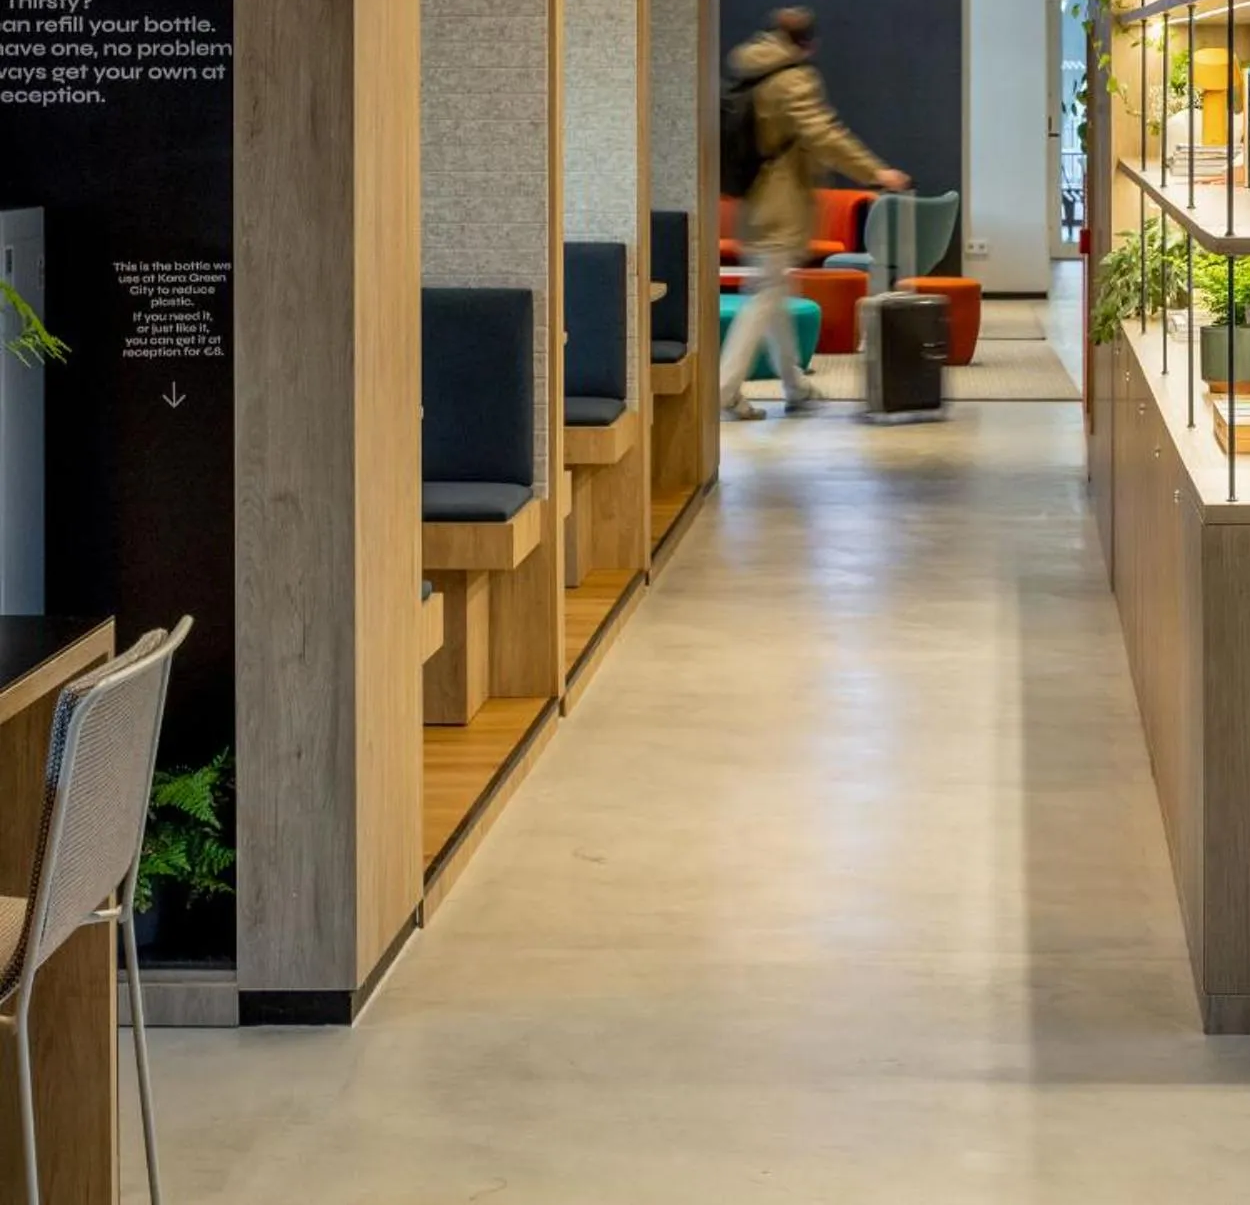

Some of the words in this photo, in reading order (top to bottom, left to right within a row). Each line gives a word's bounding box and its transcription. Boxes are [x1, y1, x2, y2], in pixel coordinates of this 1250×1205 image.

[35, 15, 83, 33] refill
[89, 19, 139, 37] your
[144, 15, 216, 33] bottle.
[51, 43, 98, 59] one,
[103, 43, 132, 57] no
[52, 64, 89, 84] get
[94, 67, 143, 84] your
[148, 67, 196, 80] own
[202, 63, 226, 80] at
[113, 261, 137, 271] This
[139, 261, 149, 271] is
[152, 261, 172, 271] the
[174, 261, 211, 271] bottle
[118, 276, 140, 284] use
[130, 285, 154, 297] City
[157, 285, 170, 295] to
[172, 285, 216, 295] reduce
[133, 311, 142, 321] If
[144, 313, 168, 324] you
[170, 311, 200, 322] need
[137, 326, 150, 334] or
[152, 323, 174, 335] just
[176, 323, 197, 333] like
[125, 338, 148, 348] you
[123, 347, 181, 360] reception
[184, 347, 201, 356] for
